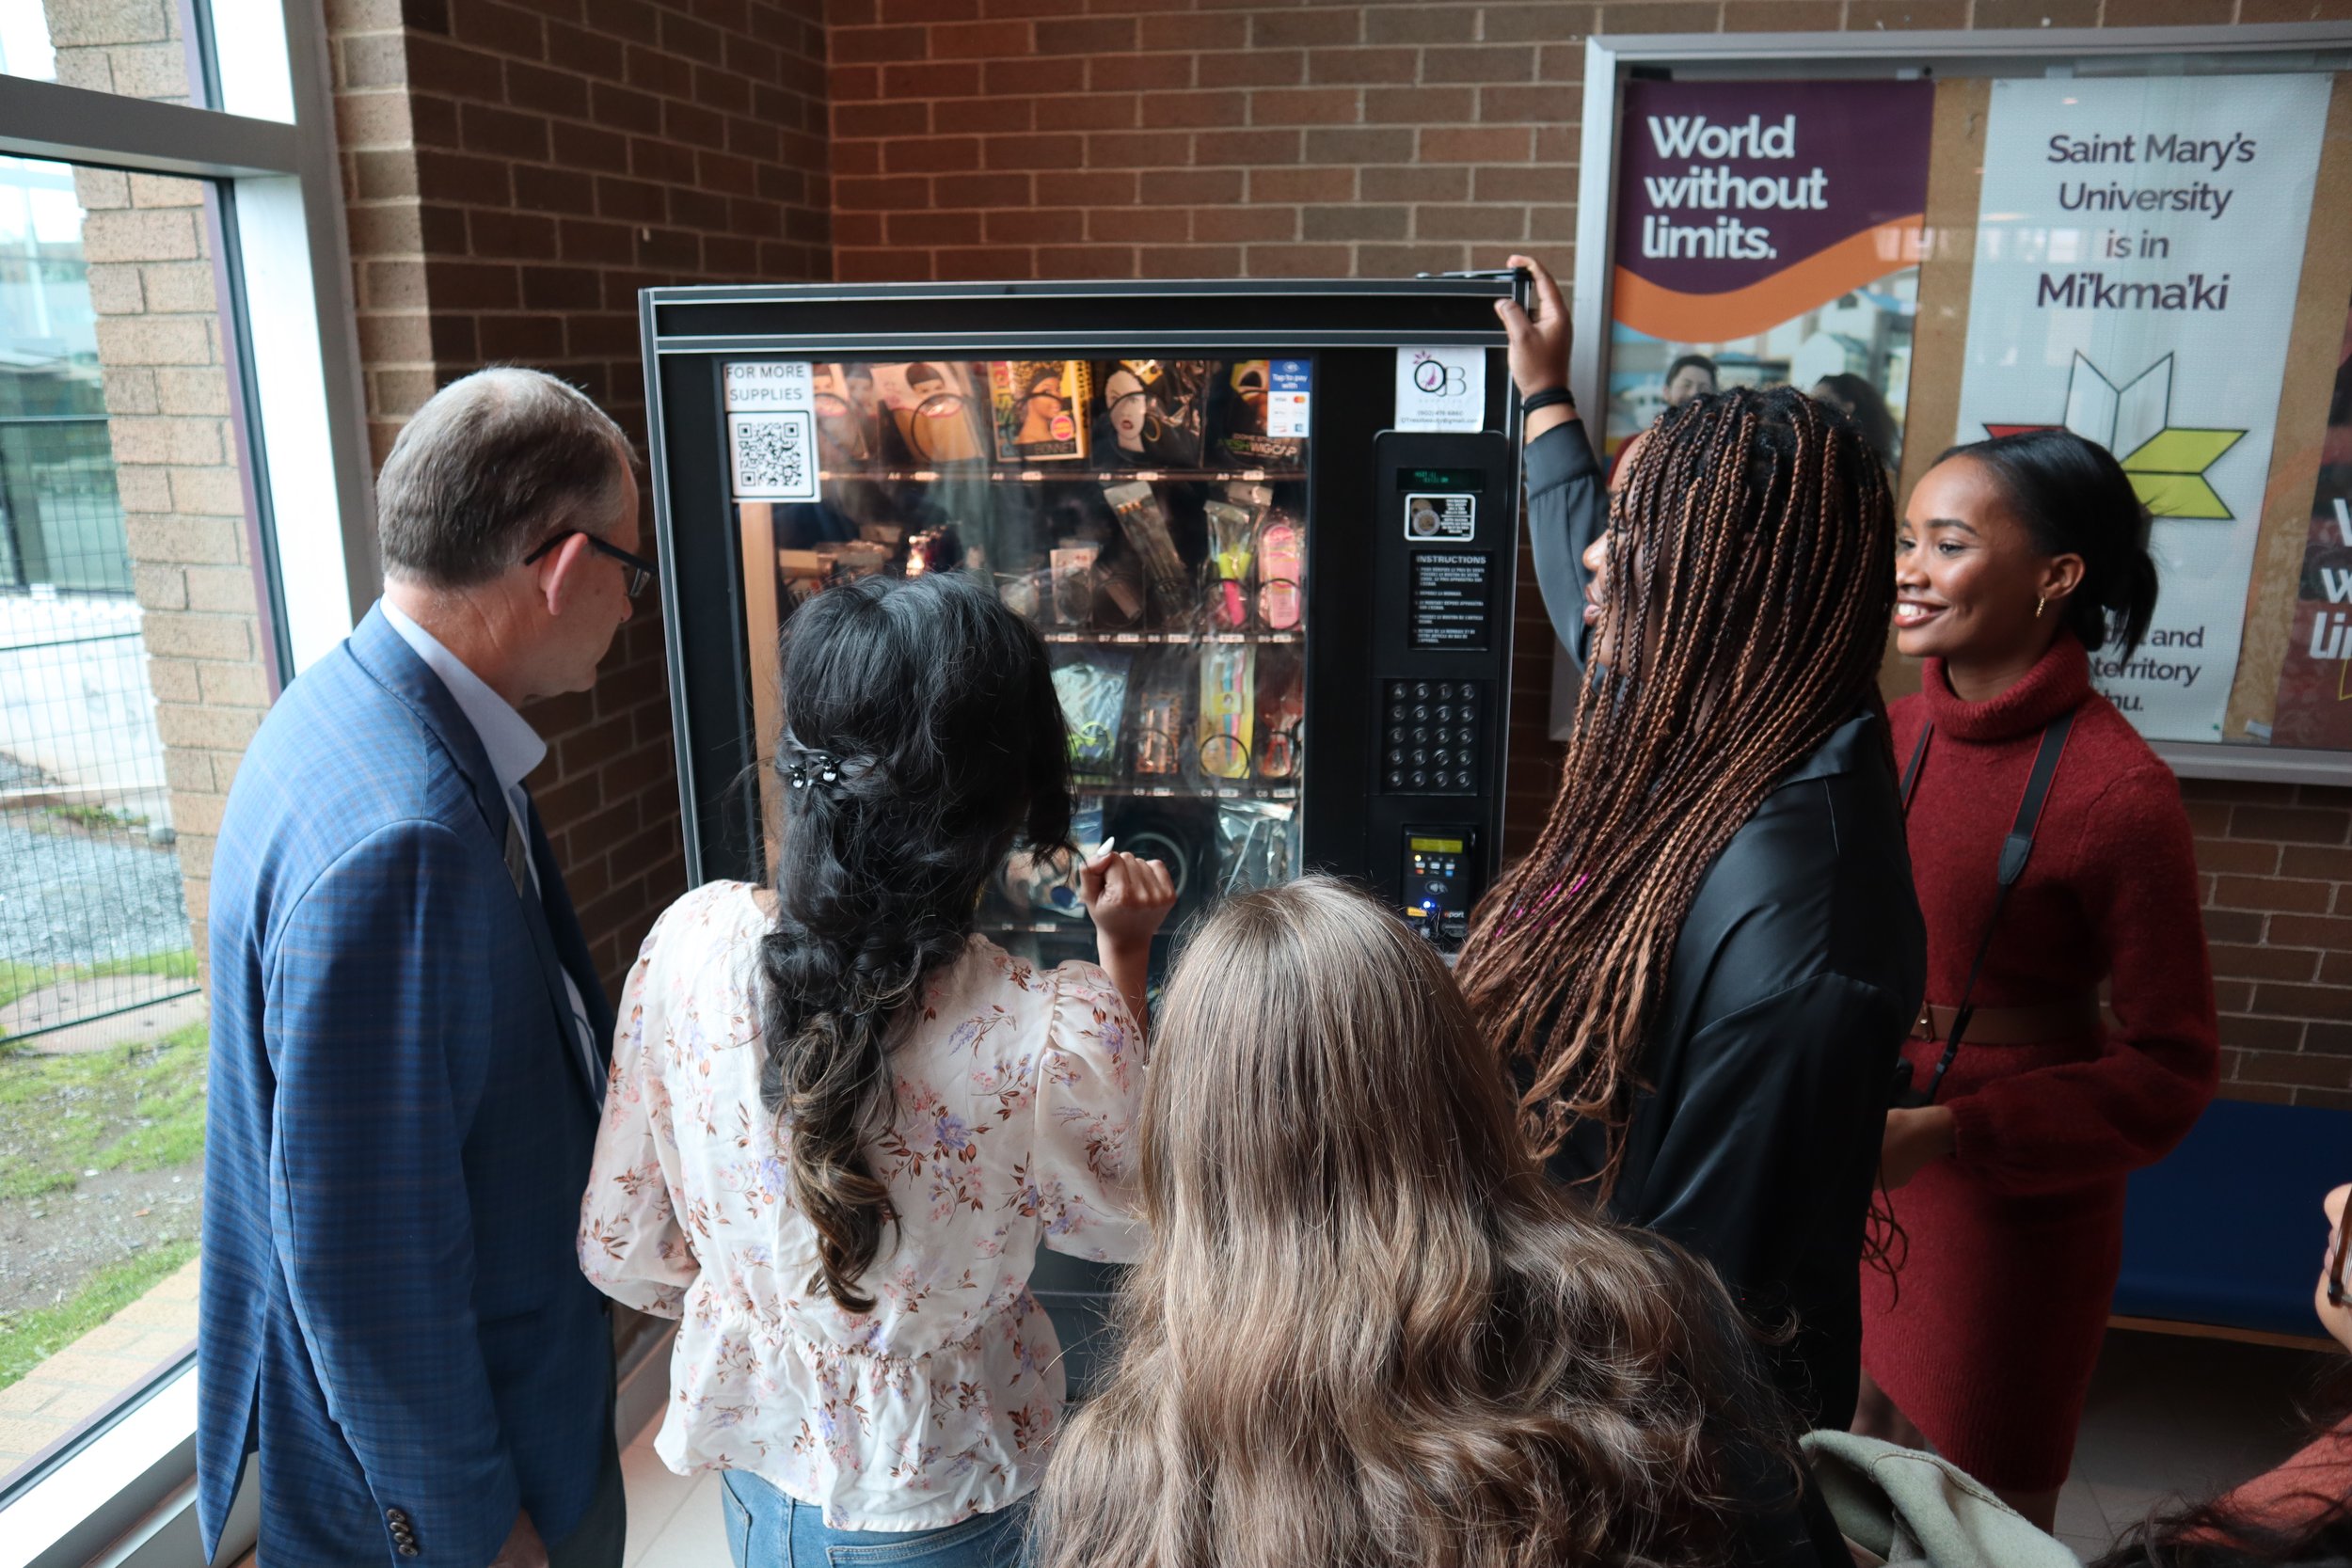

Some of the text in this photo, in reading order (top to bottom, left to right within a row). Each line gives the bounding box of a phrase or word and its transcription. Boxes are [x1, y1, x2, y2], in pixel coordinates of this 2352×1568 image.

[1646, 114, 1796, 159] World
[2047, 132, 2257, 171] Saint Mary's
[1644, 165, 1828, 210] without
[2058, 181, 2233, 220] University
[1642, 215, 1777, 260] limits.
[2106, 230, 2169, 259] is in
[726, 365, 804, 379] FOR MORE
[729, 388, 803, 401] SUPPLIES
[1416, 555, 1486, 564] INSTRUCTIONS
[2151, 626, 2205, 648] and
[2093, 657, 2201, 689] territory
